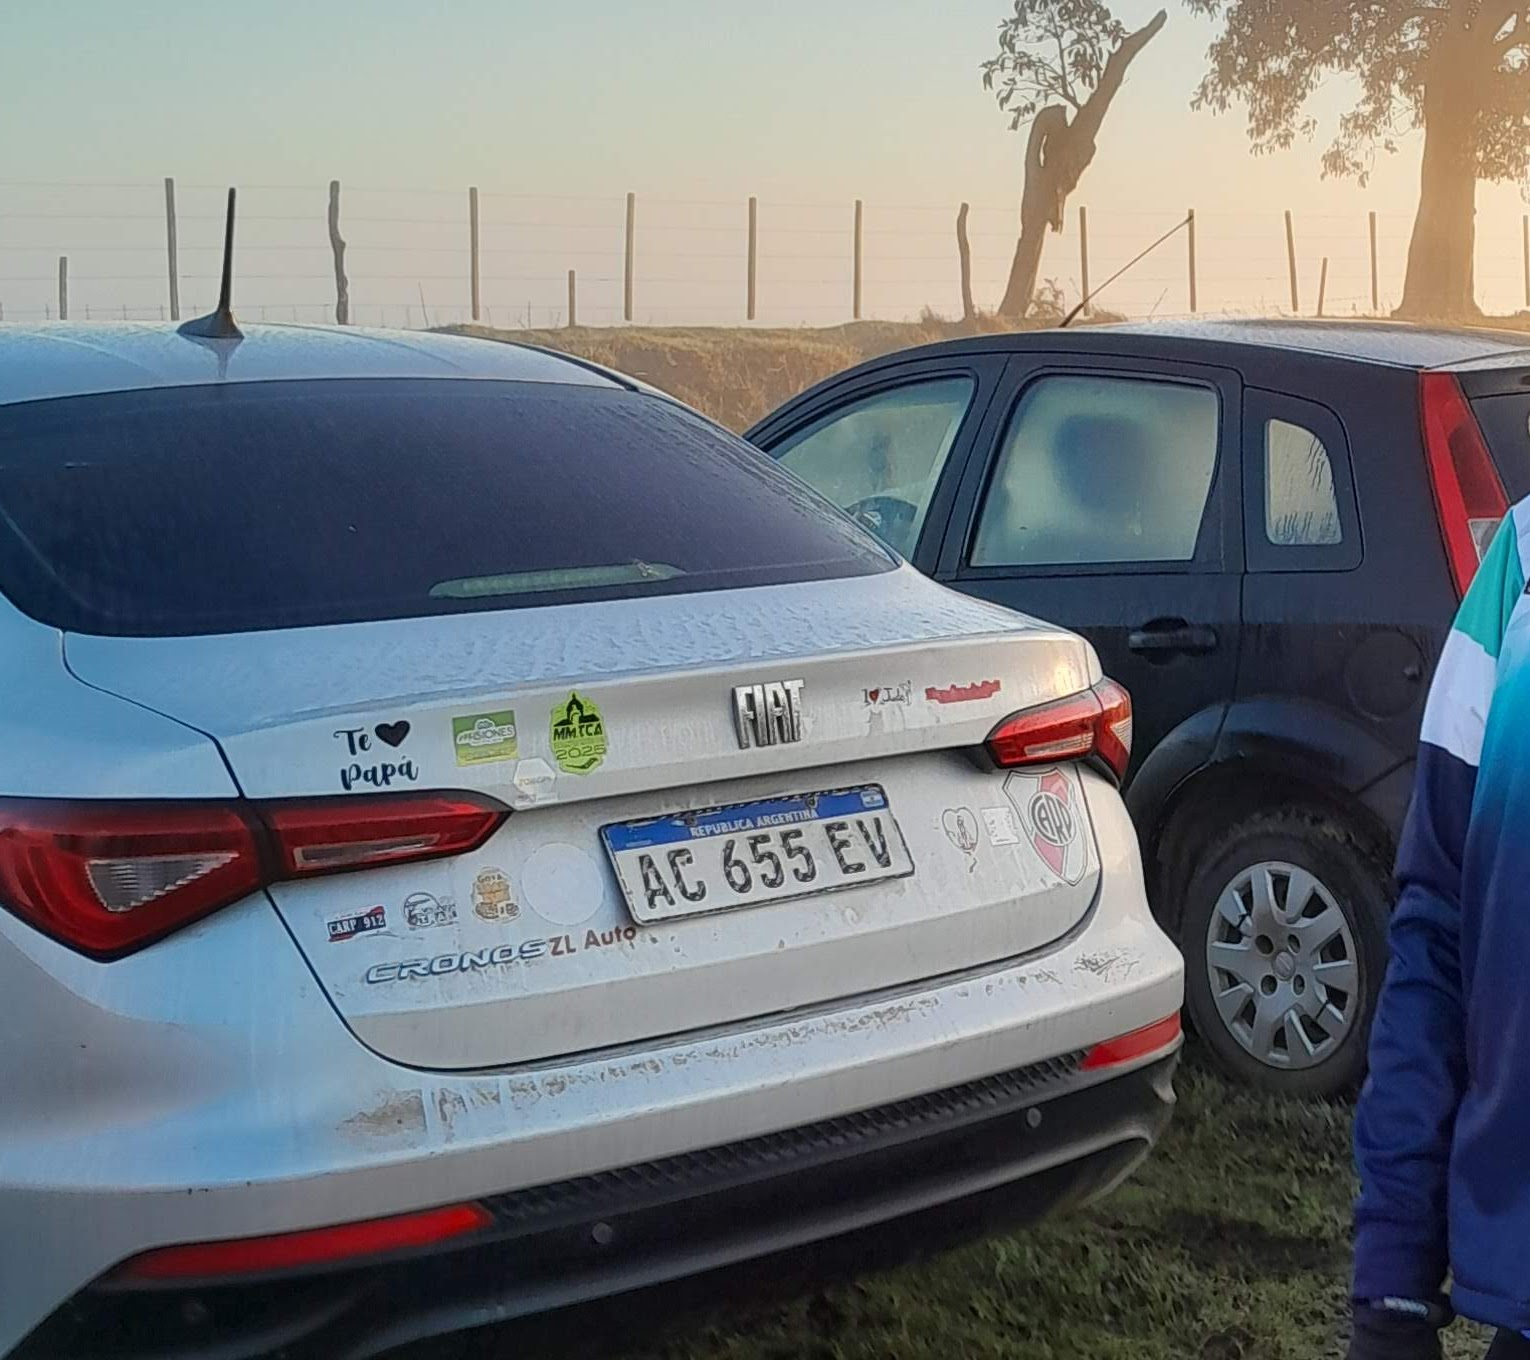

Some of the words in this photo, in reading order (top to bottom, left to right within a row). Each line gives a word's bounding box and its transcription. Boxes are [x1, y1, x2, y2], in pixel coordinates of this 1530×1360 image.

[732, 678, 805, 750] FIAT
[333, 726, 372, 756] Te
[555, 744, 605, 761] 2025
[755, 808, 820, 829] ARGENTINA
[638, 848, 707, 910] AC
[722, 828, 817, 894] 655
[824, 816, 893, 875] EV
[549, 938, 577, 957] ZL
[583, 926, 637, 950] Auto
[366, 938, 548, 984] CRONOS
